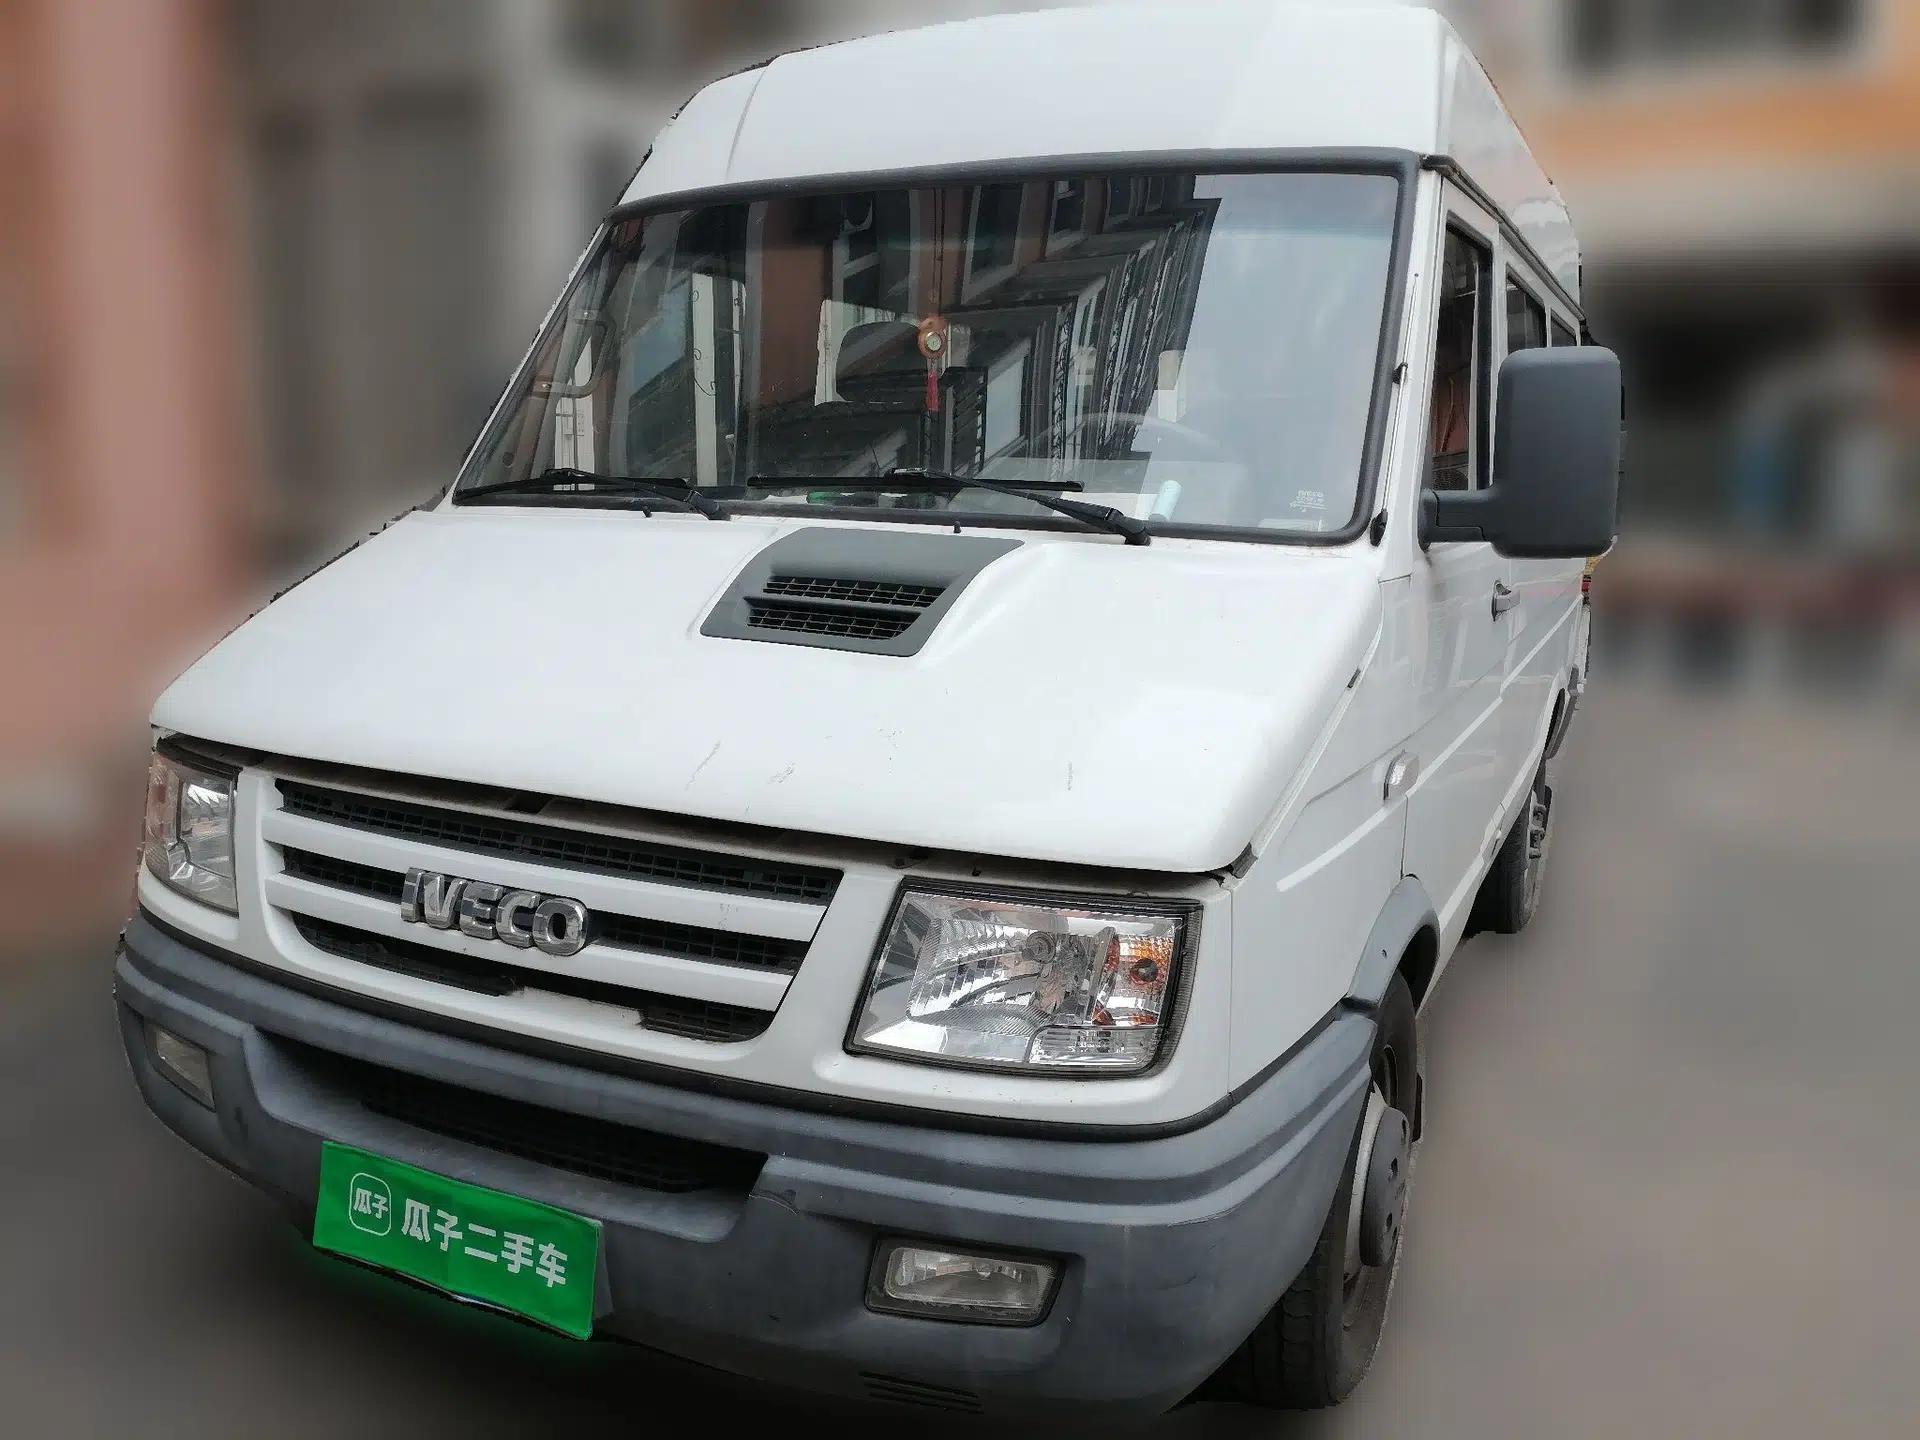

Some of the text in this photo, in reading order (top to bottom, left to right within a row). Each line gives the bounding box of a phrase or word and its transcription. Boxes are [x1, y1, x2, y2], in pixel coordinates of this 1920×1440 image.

[401, 867, 588, 956] IVECO
[353, 1188, 388, 1219] 瓜子
[401, 1198, 568, 1287] 瓜子二手车
